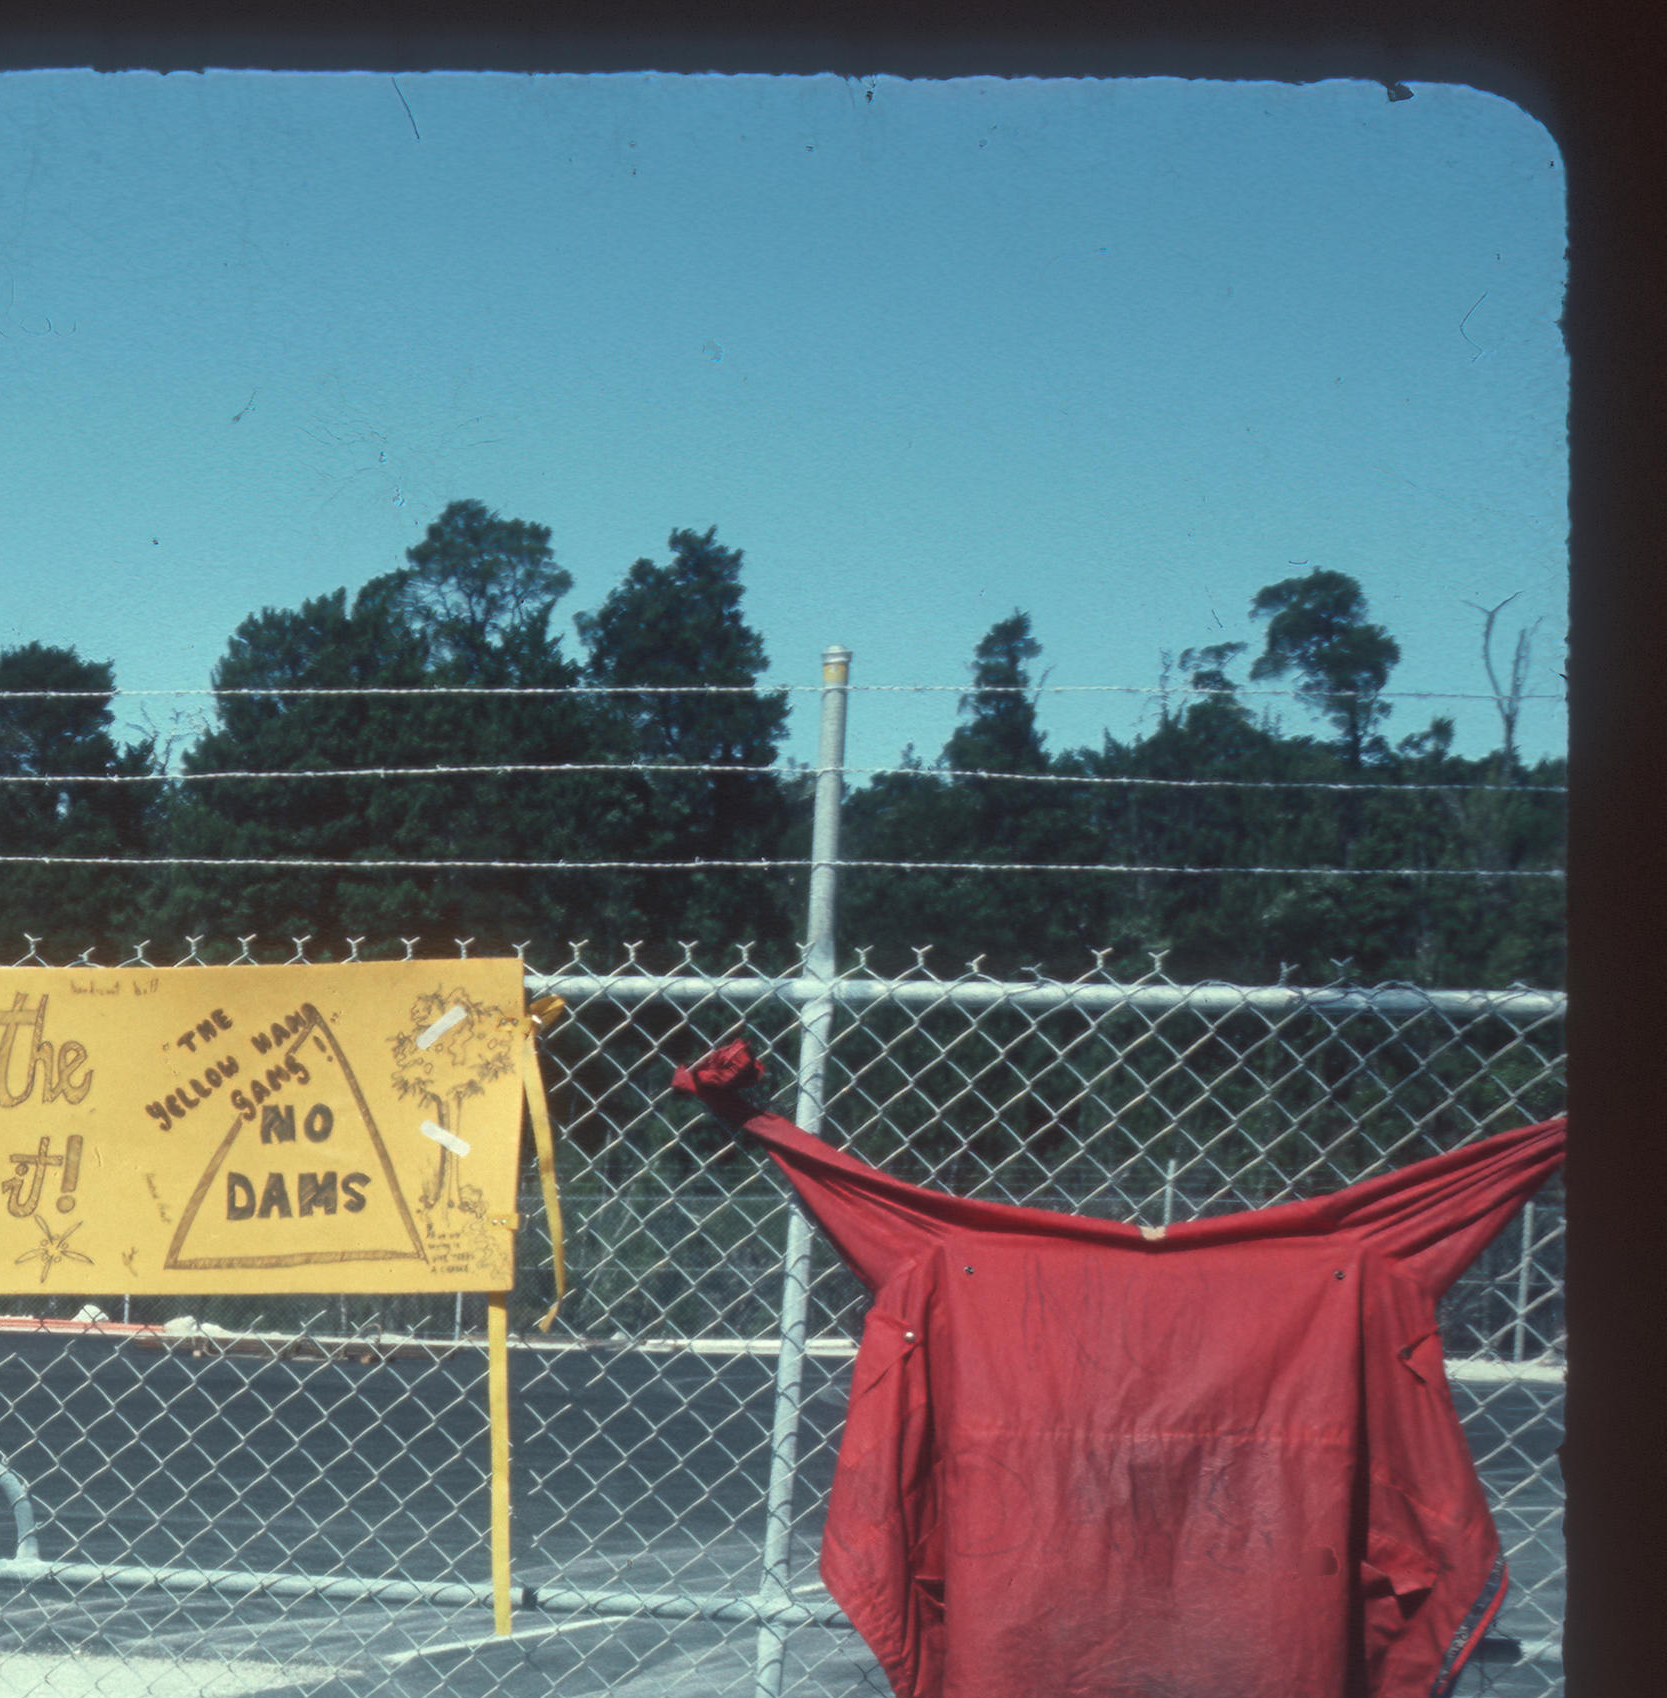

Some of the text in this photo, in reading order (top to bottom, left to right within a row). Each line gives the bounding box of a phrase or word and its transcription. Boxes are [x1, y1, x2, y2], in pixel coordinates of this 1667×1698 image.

[176, 1008, 234, 1052] THE
[145, 1055, 240, 1132] YELLOW
[260, 1103, 336, 1144] NO
[226, 1170, 372, 1221] DAMS
